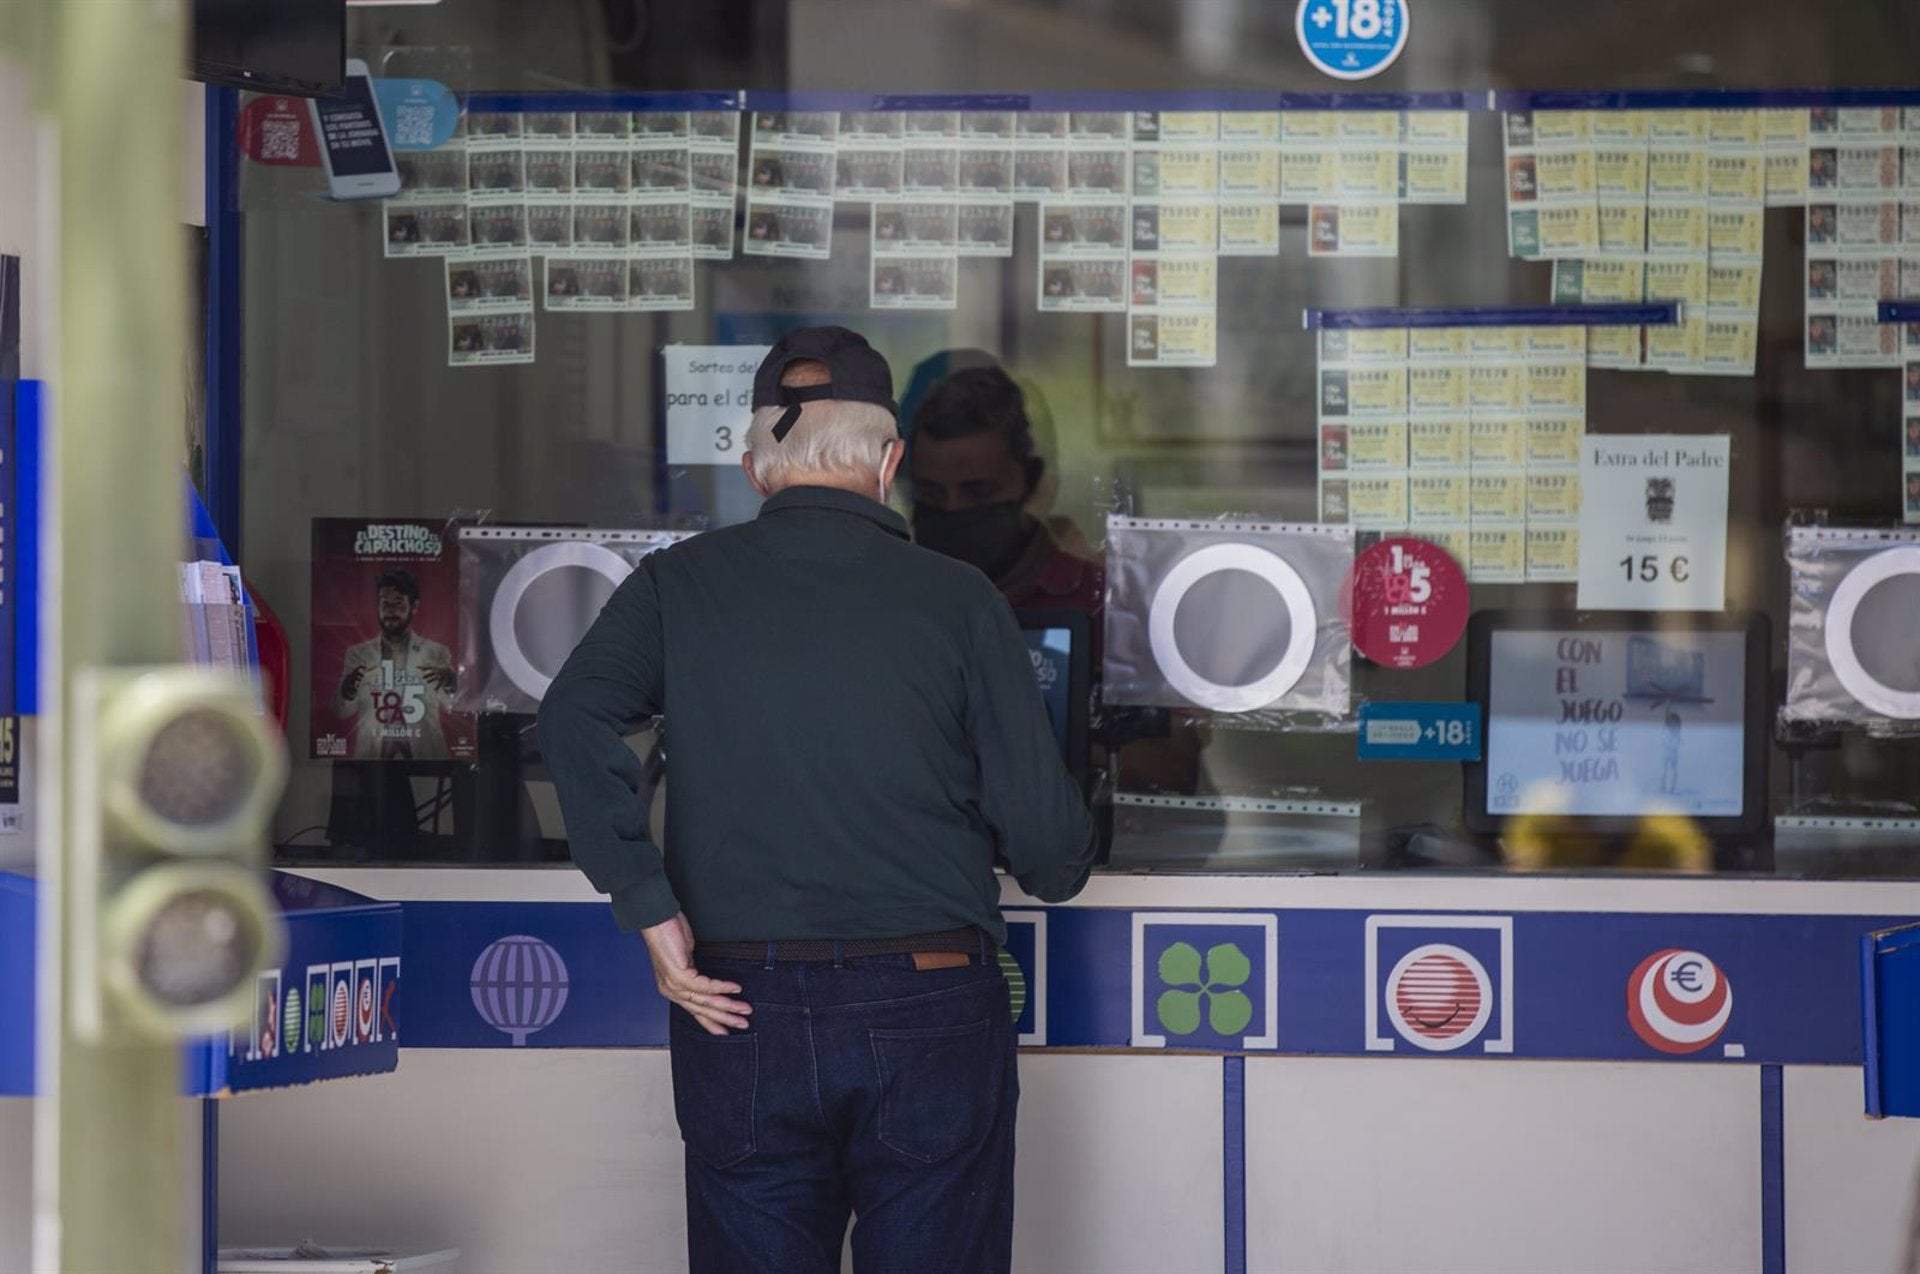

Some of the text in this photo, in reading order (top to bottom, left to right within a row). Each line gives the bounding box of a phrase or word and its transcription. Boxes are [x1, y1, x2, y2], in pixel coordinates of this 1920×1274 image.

[1311, 0, 1380, 39] +18
[689, 361, 734, 374] Sorteo
[667, 393, 708, 411] para
[714, 388, 730, 406] el
[715, 425, 732, 451] 3
[1594, 450, 1724, 467] Extra del Padre
[367, 524, 429, 540] DESTINO
[354, 539, 442, 556] CAPRICHOSO
[1390, 545, 1404, 575] 1
[1620, 556, 1690, 583] 15 €
[1411, 566, 1432, 604] 5
[1556, 636, 1603, 664] CON
[381, 660, 395, 690] 1
[1556, 667, 1579, 694] EL
[403, 684, 426, 725] 5
[1556, 700, 1624, 725] JUEGO
[1424, 719, 1465, 746] +18
[1555, 727, 1619, 755] NO SE
[1555, 757, 1621, 786] JUEGA
